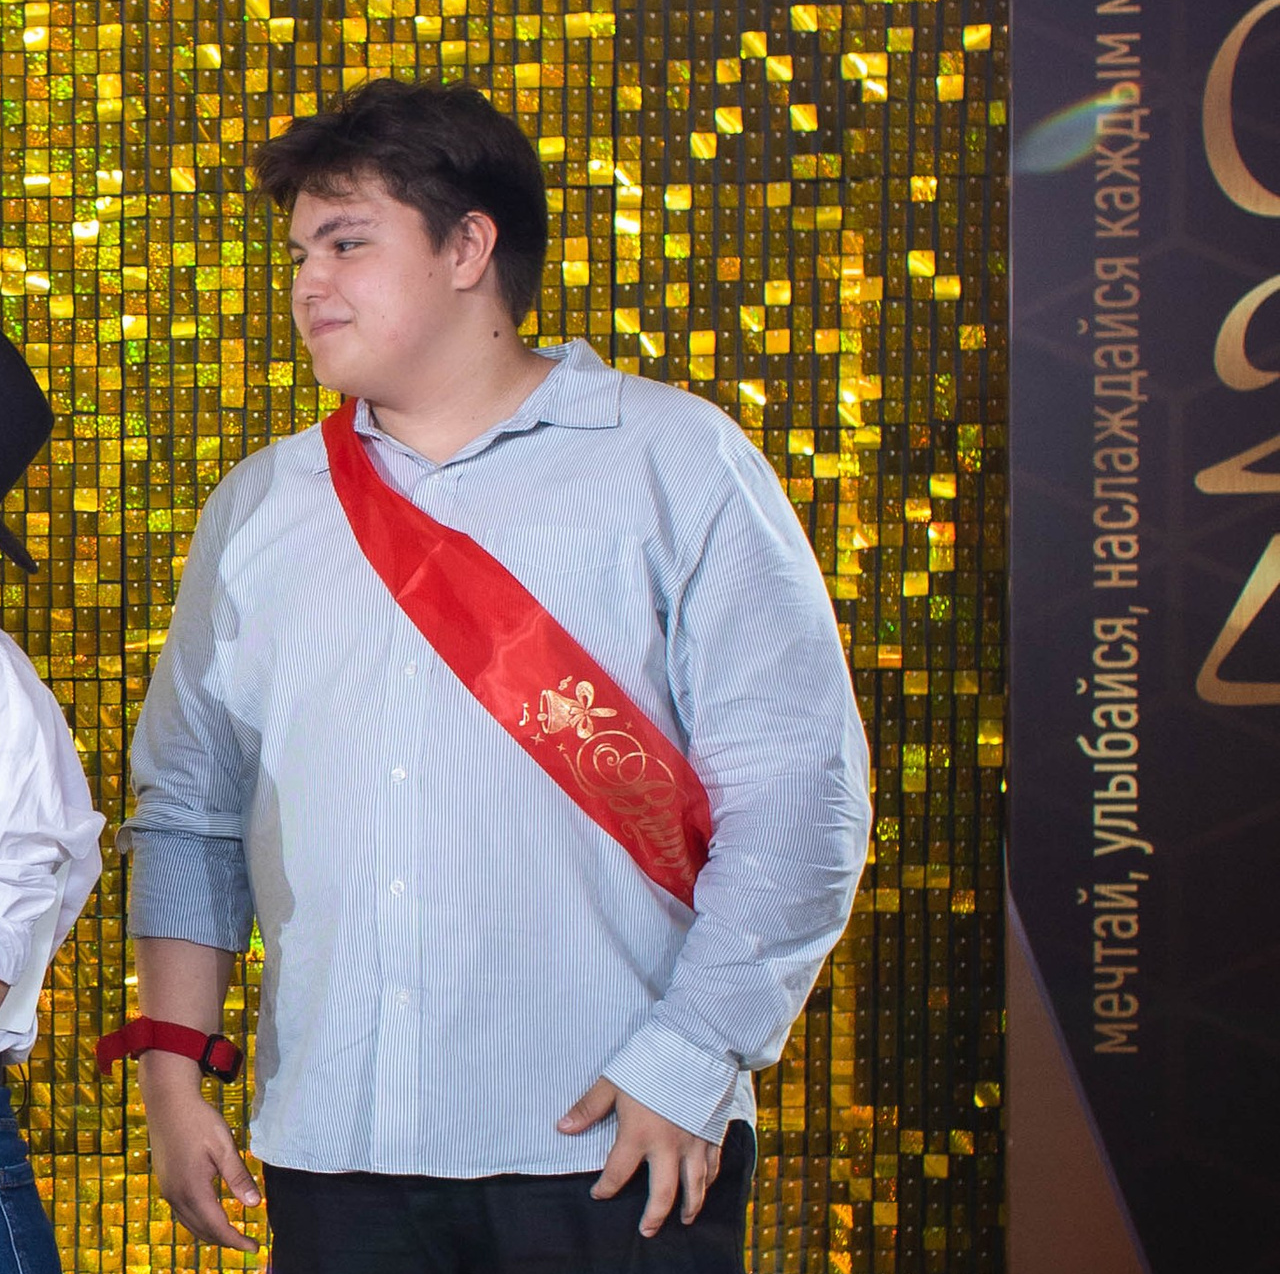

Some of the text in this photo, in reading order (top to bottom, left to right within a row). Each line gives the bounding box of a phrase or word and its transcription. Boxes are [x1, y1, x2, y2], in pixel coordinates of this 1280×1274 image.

[1094, 33, 1148, 239] каждым
[1078, 256, 1148, 589] наслаждайся
[1077, 605, 1153, 858] улыбайся,
[1078, 872, 1149, 1054] мечтай,
